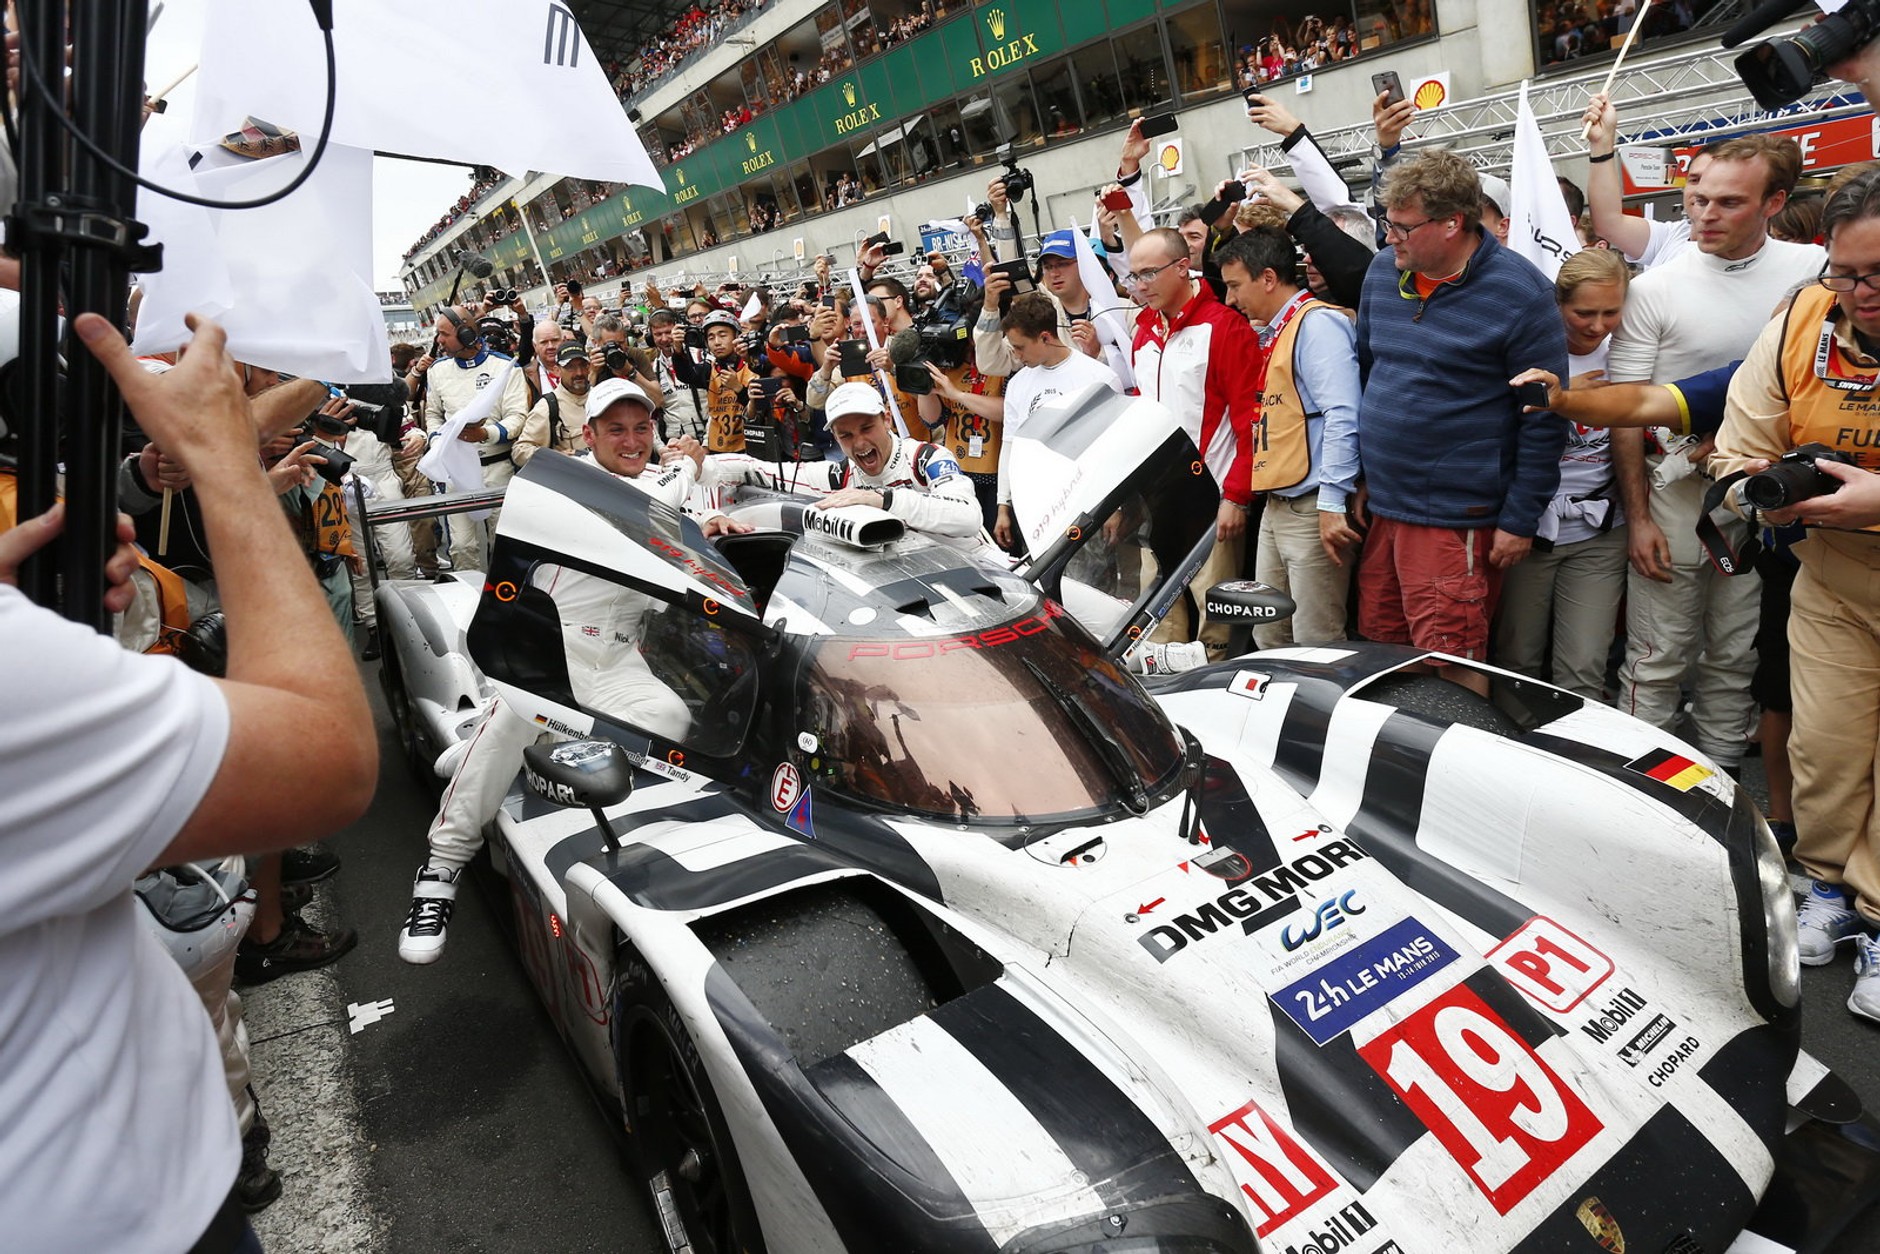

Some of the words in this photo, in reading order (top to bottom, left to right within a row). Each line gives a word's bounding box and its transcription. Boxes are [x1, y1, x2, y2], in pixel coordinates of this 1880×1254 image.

[969, 33, 1039, 78] ROLEX
[834, 103, 881, 135] ROLEX
[742, 151, 774, 175] ROLEX
[674, 184, 699, 205] ROLEX
[622, 211, 643, 227] ROLEX
[1839, 402, 1855, 411] LE
[649, 537, 685, 558] 919
[1720, 556, 1735, 573] EOS
[1207, 601, 1277, 617] CHOPARD
[667, 766, 691, 782] Tandy
[1137, 889, 1262, 964] DMG
[1281, 889, 1366, 952] WEC
[1271, 966, 1283, 976] FIA
[1284, 953, 1310, 968] WORLD
[1295, 979, 1350, 1022] 24h
[1346, 969, 1379, 996] LE
[1373, 936, 1434, 979] MANS
[1505, 935, 1592, 996] P1
[1581, 1000, 1636, 1044] Mobil
[1635, 1014, 1670, 1050] MICHELIN
[1648, 1036, 1700, 1088] CHOPARD
[1386, 1006, 1569, 1195] 19
[1285, 1216, 1355, 1254] obil
